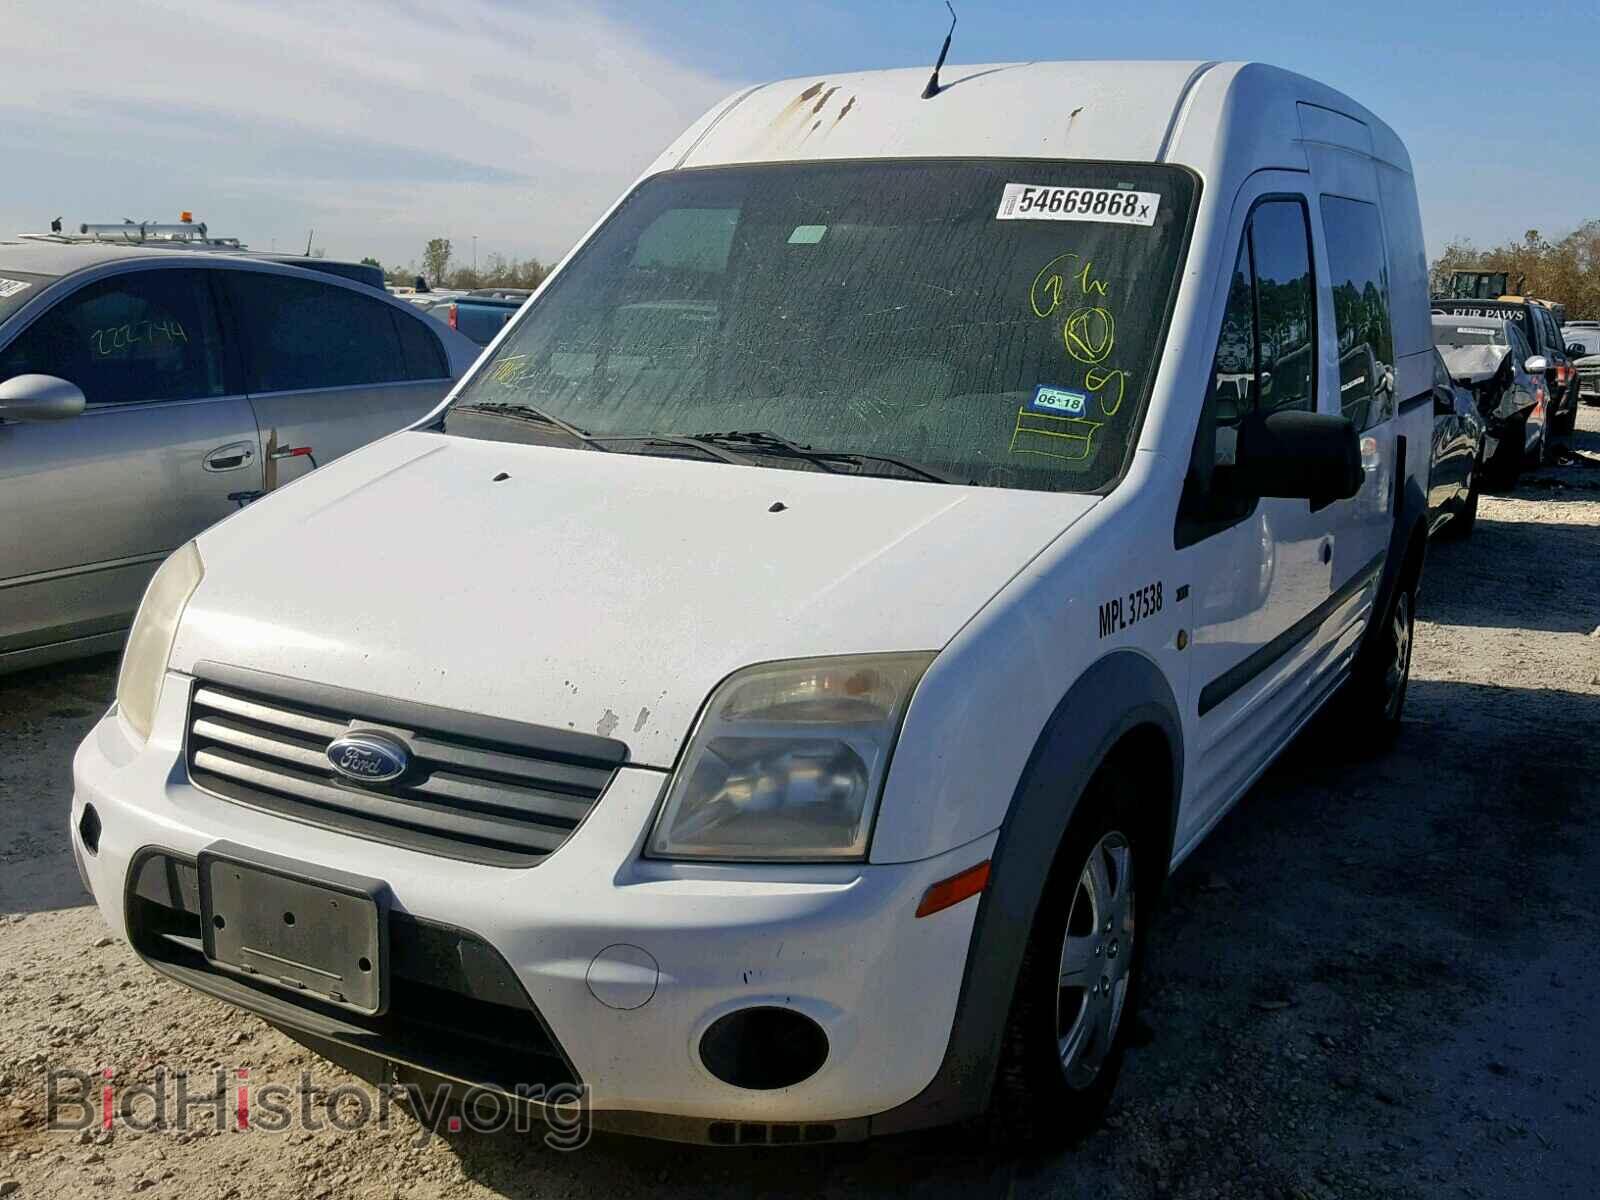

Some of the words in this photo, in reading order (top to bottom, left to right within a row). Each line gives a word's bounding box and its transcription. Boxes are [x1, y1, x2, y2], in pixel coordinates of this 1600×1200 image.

[1019, 187, 1139, 217] 54669868
[1485, 309, 1525, 321] PAWS
[1099, 596, 1127, 640] MPL
[1128, 580, 1163, 625] 37538
[340, 746, 382, 774] Ford
